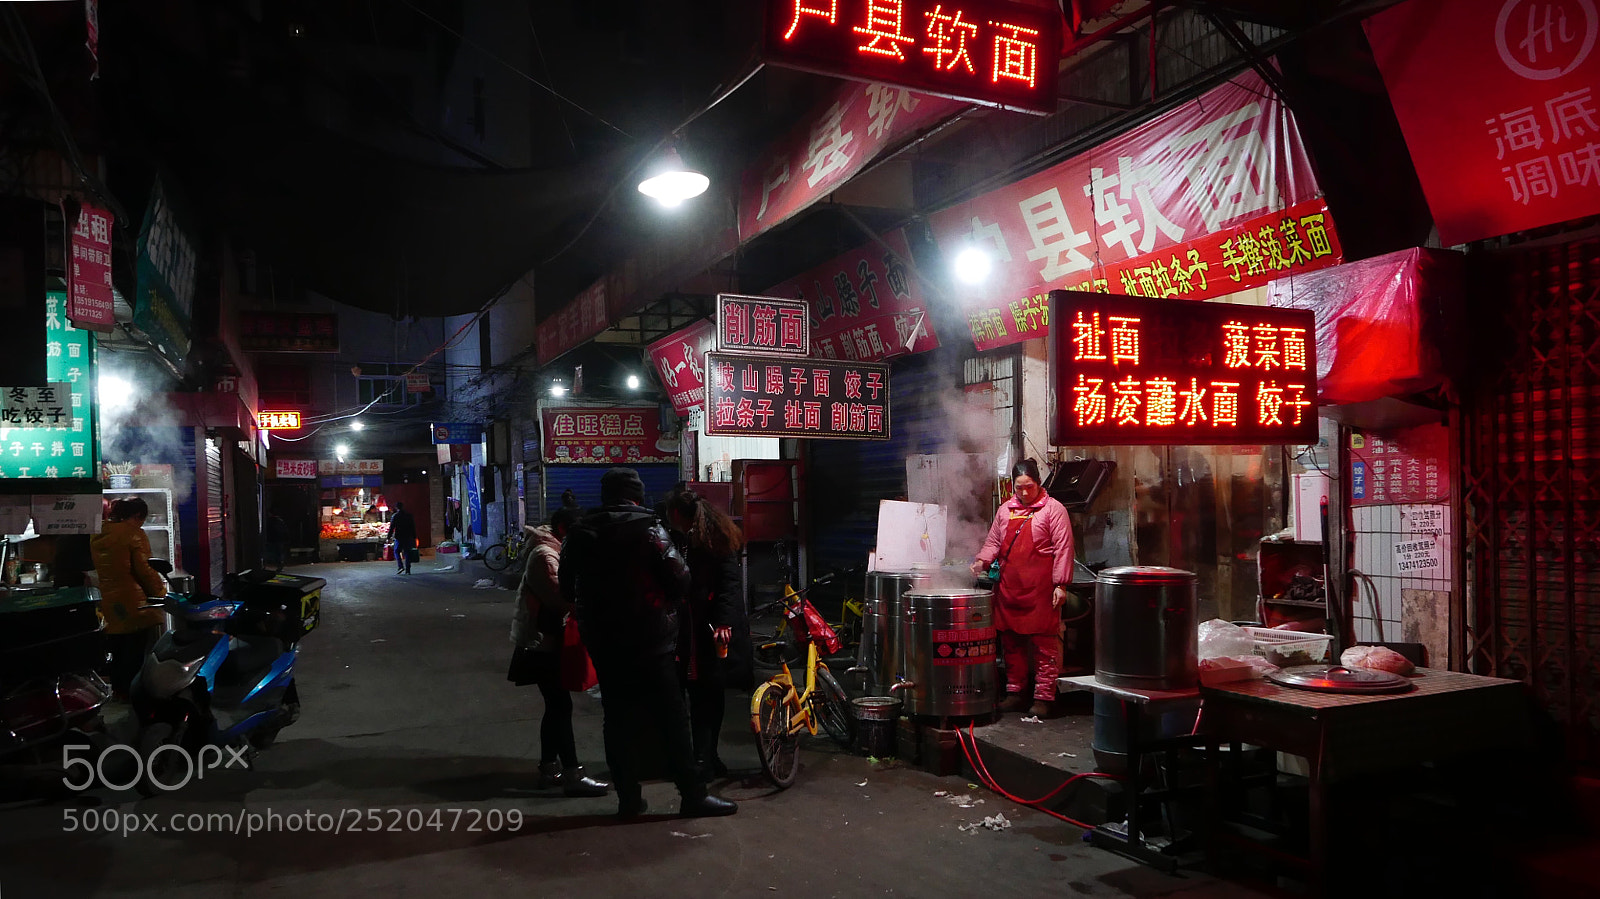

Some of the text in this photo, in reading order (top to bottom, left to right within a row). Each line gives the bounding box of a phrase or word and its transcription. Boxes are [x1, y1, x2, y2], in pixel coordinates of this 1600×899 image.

[1485, 87, 1600, 160] 海底
[74, 208, 109, 244] 出租
[1219, 213, 1332, 283] 手擀菠菜面
[725, 302, 803, 348] 削筋面
[1073, 312, 1307, 371] 扯面 菠菜面
[9, 386, 56, 403] 冬至
[716, 361, 830, 398] 岐山臊子面
[844, 370, 883, 400] 饺子
[2, 406, 66, 424] 吃饺子
[716, 398, 775, 428] 拉条子
[784, 400, 821, 430] 扯面
[831, 402, 883, 433] 削筋面
[1073, 374, 1312, 426] 杨凌蘸水面 饺子
[553, 413, 645, 436] 佳旺糕点
[0, 440, 85, 456] 子干拌面
